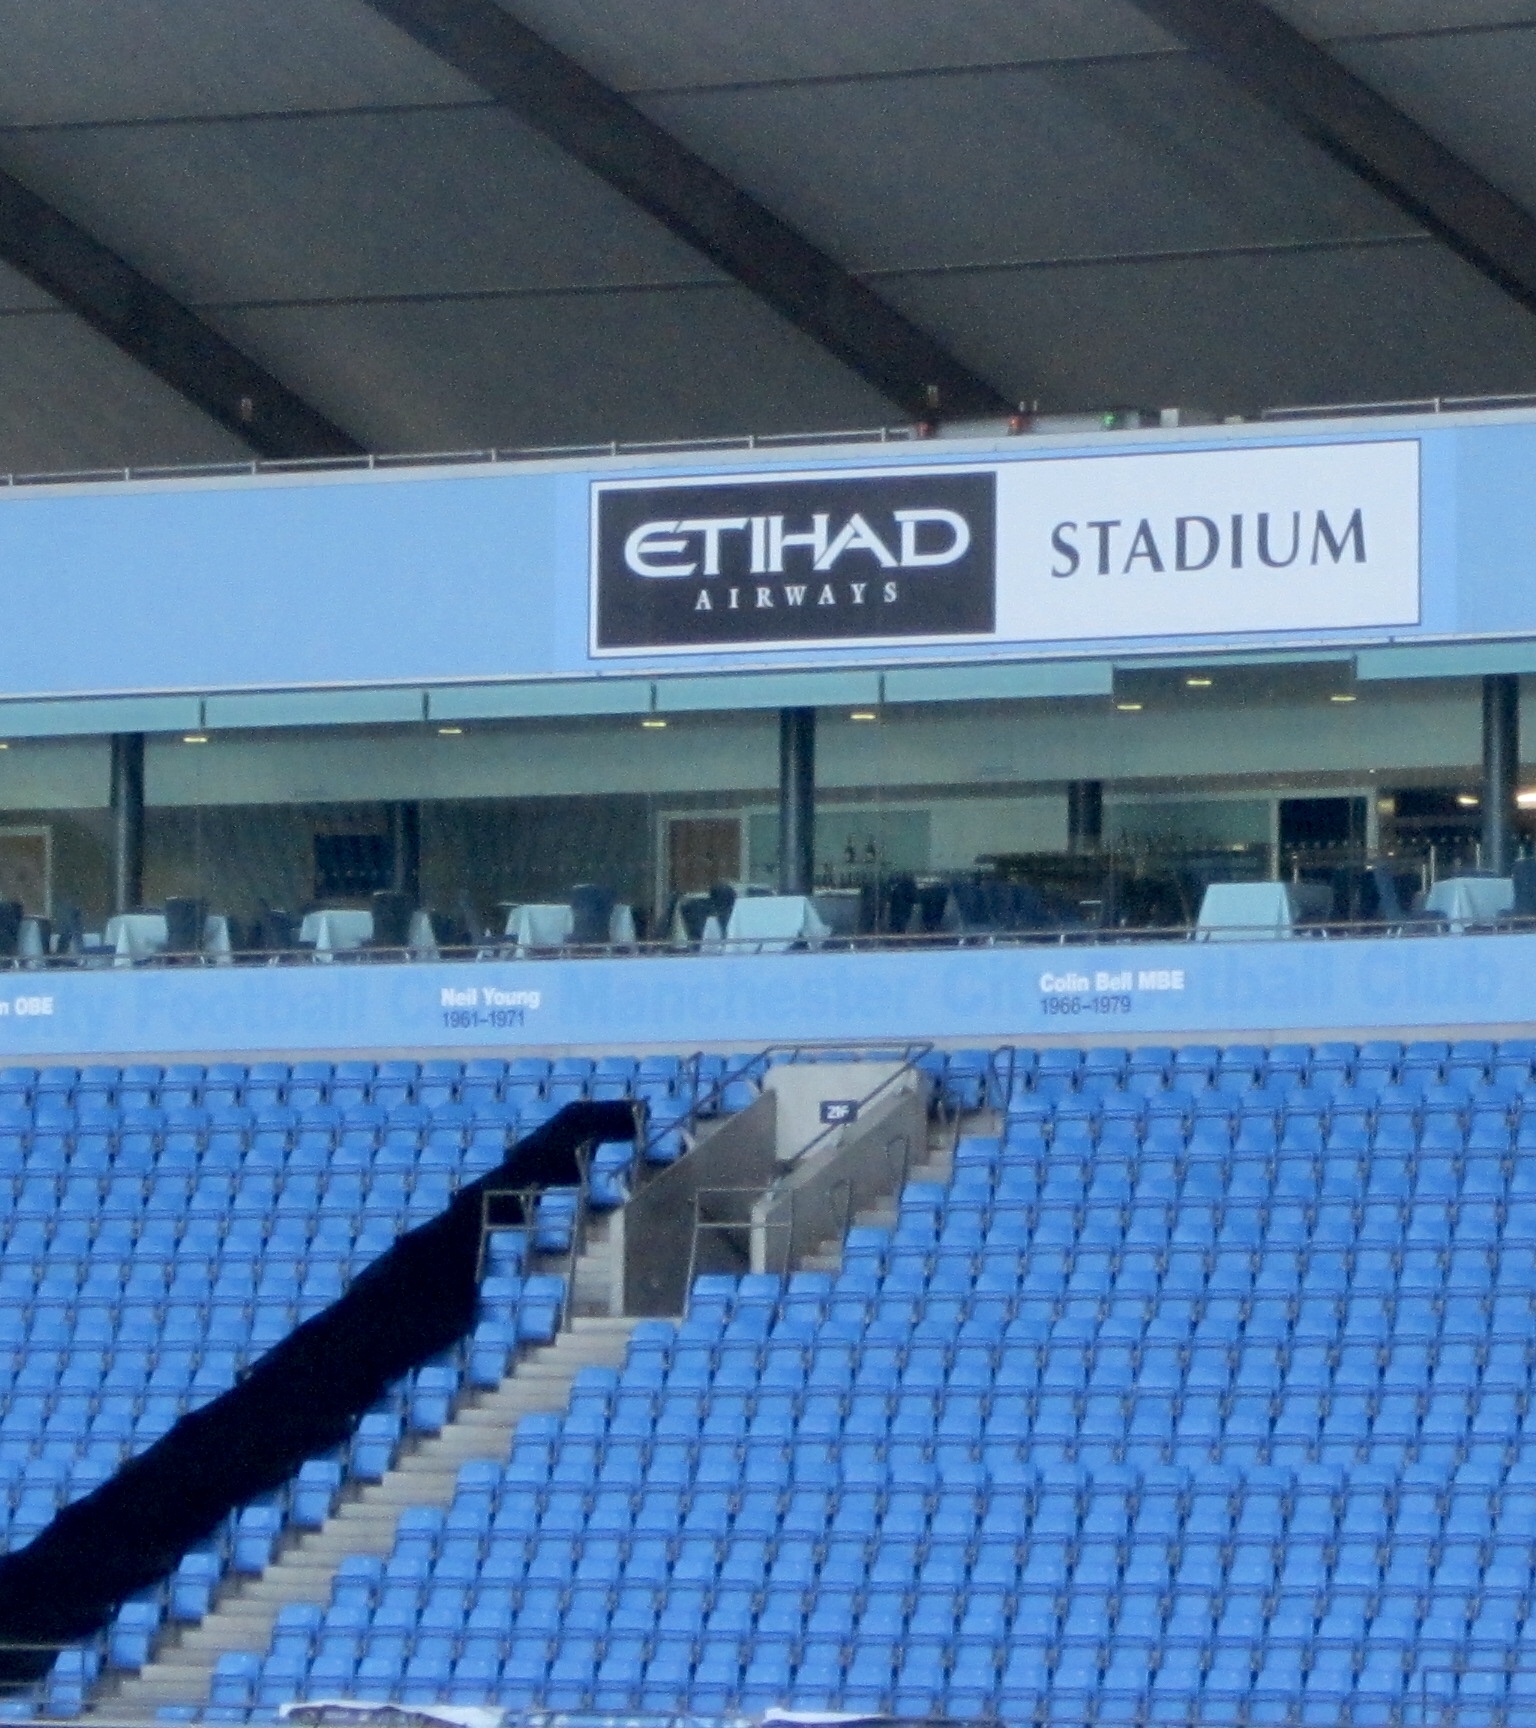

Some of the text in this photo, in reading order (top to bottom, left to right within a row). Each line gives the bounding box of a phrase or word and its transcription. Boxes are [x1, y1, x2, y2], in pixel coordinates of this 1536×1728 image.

[624, 508, 971, 578] ETIHAD
[1050, 507, 1368, 578] STADIUM
[694, 581, 898, 611] AIRWAYS
[1040, 970, 1185, 992] Colin Bell MBE
[15, 996, 54, 1015] OBE
[441, 987, 541, 1010] Neil Young
